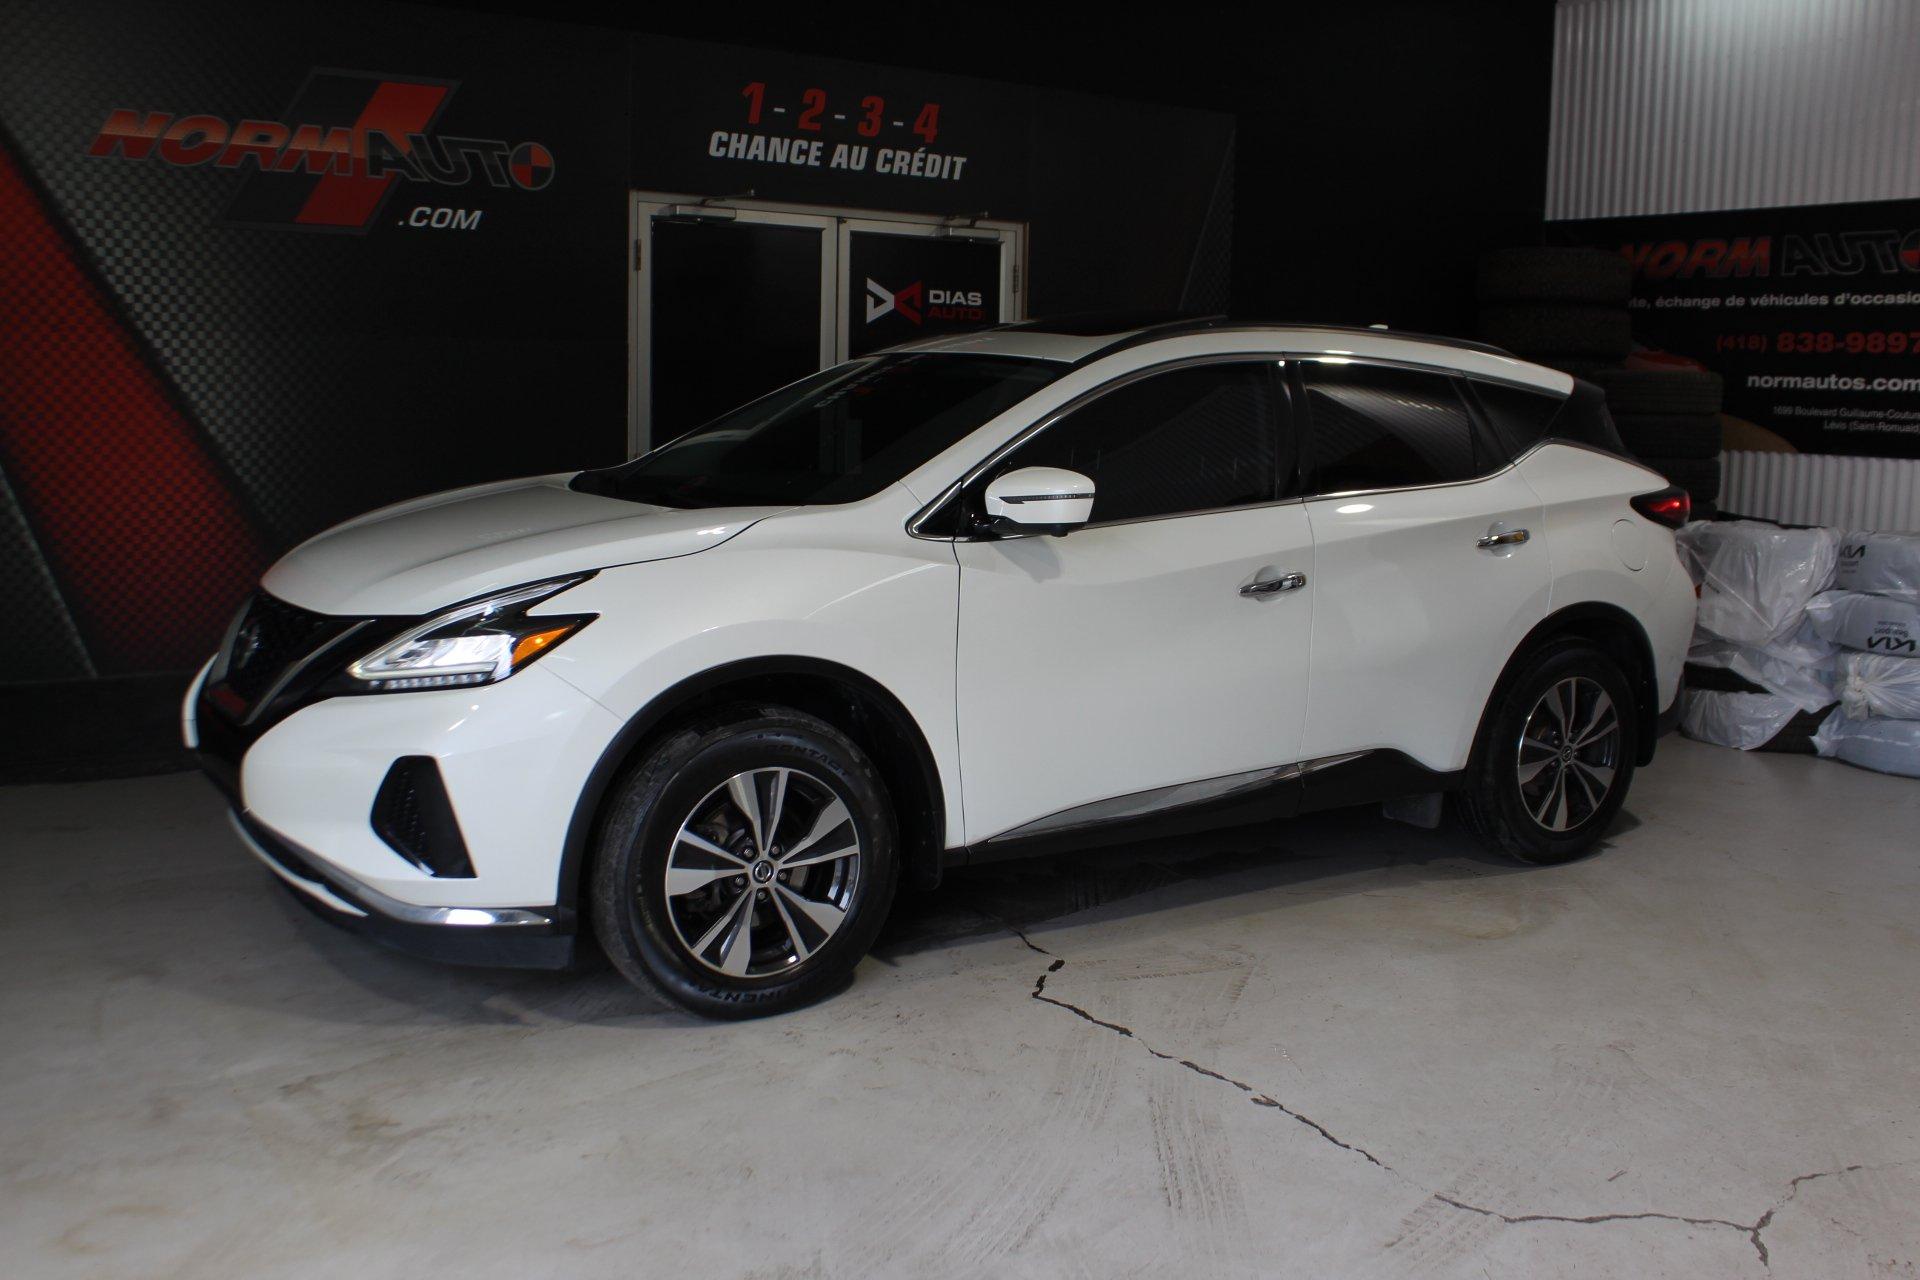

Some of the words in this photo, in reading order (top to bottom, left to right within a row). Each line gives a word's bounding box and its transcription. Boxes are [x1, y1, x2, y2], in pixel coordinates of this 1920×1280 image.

[708, 130, 825, 168] CHANCE
[829, 143, 869, 171] AU
[874, 146, 968, 181] CRÉDIT
[397, 205, 484, 231] .COM
[928, 289, 983, 306] DIAS
[1655, 294, 1721, 311] échange
[1725, 293, 1746, 307] de
[1750, 291, 1830, 306] véhicules
[1715, 334, 1769, 353] (418)
[1746, 374, 1920, 392] normautos.com
[1795, 406, 1838, 417] Boulevard
[1867, 635, 1916, 652] KIA
